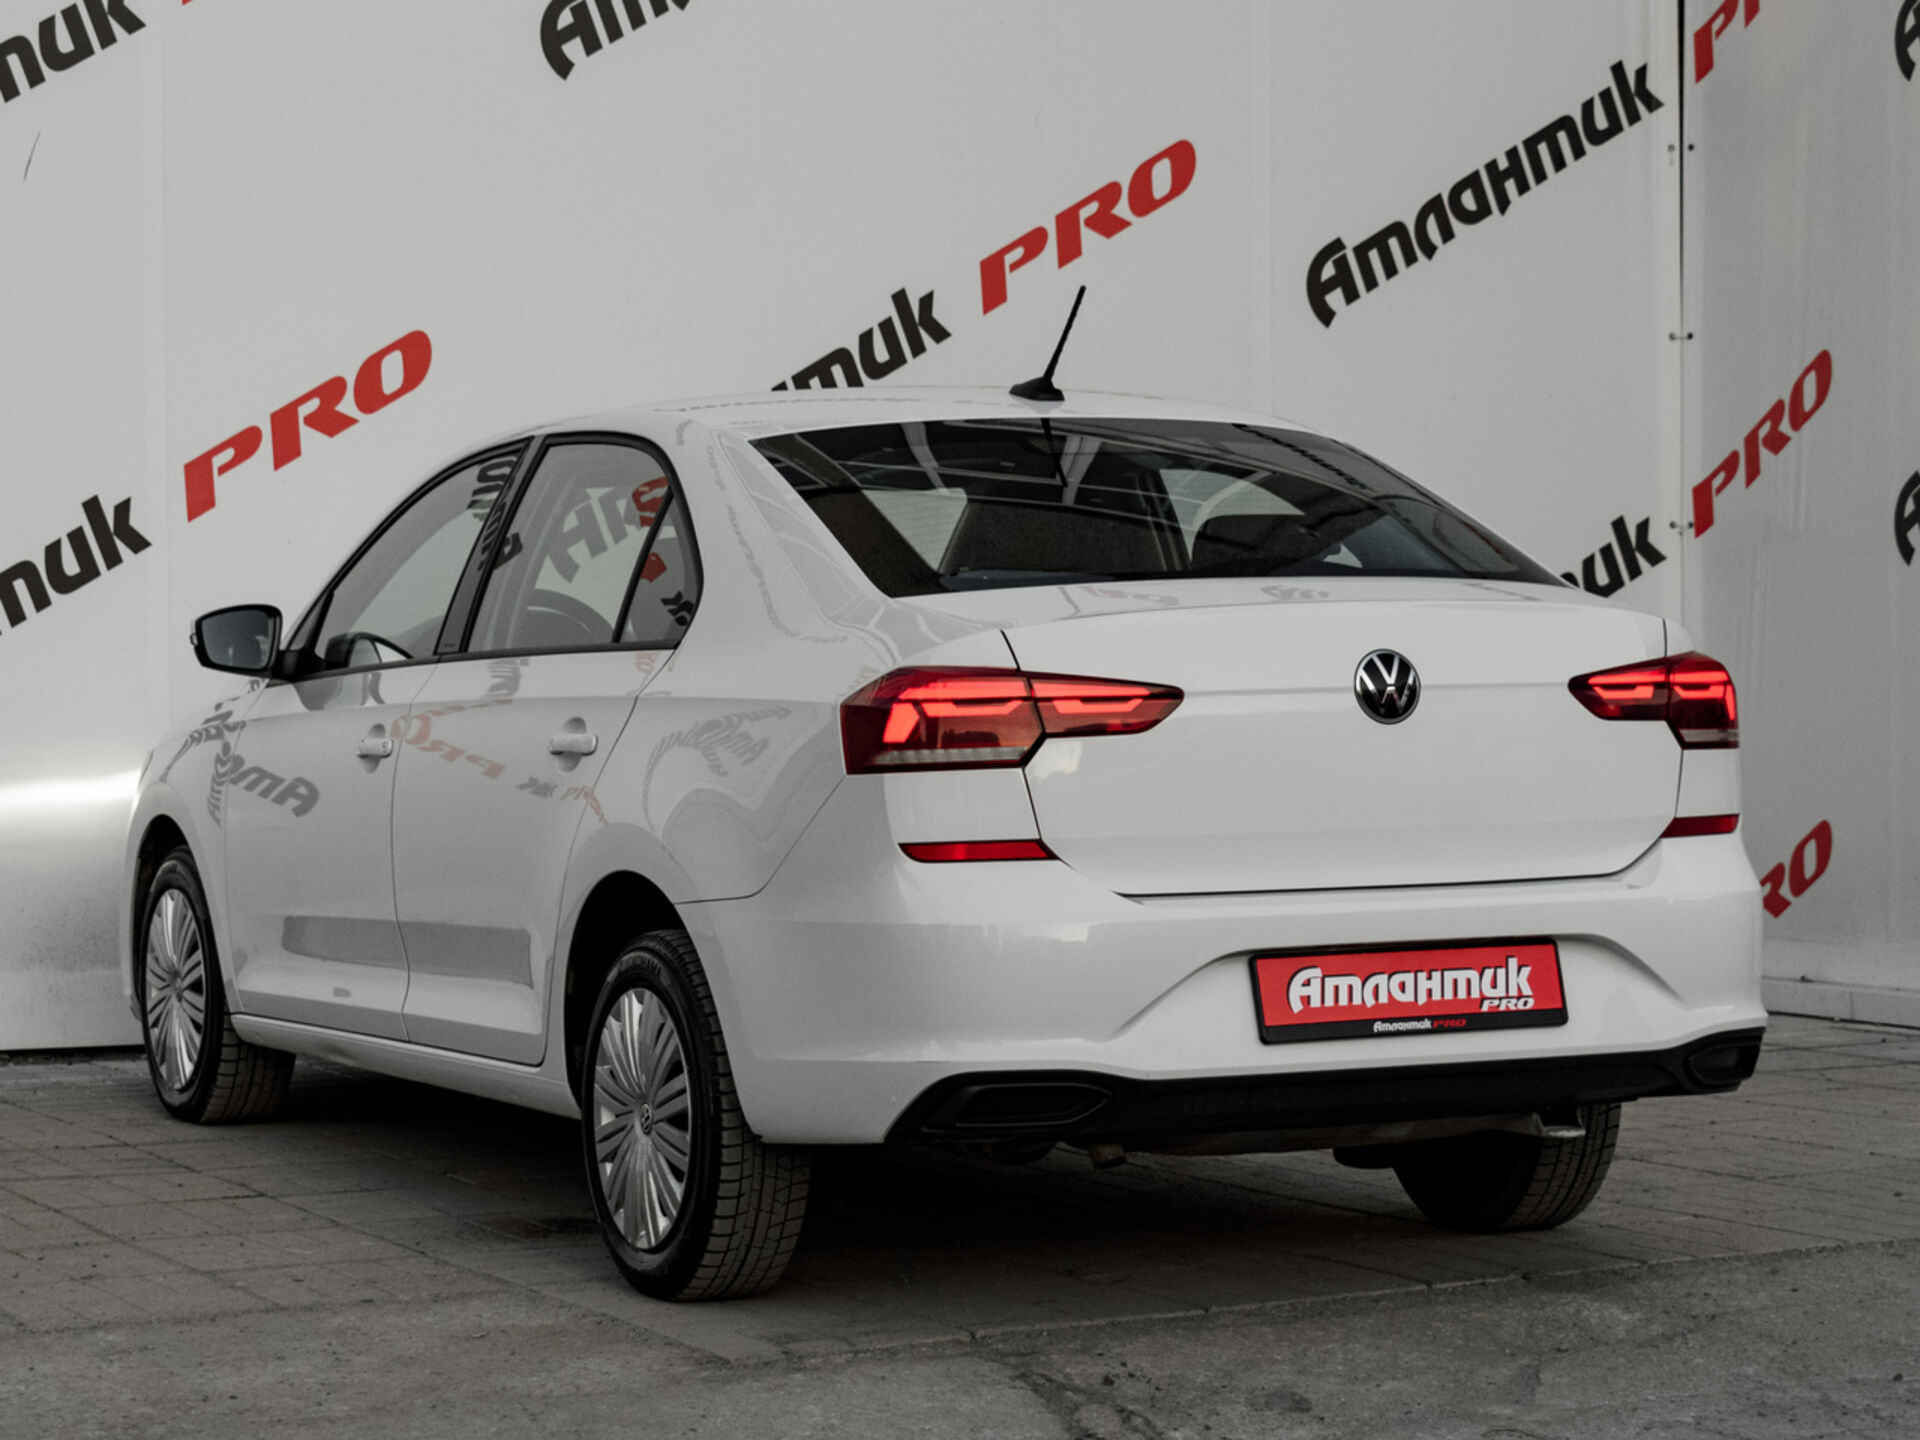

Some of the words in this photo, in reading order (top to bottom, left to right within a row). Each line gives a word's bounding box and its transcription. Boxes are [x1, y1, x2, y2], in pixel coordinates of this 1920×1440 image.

[979, 139, 1197, 315] PRO
[183, 330, 433, 523] PRO
[1691, 350, 1833, 539] PRO
[1432, 1018, 1467, 1029] PRO
[1480, 997, 1535, 1012] PRO
